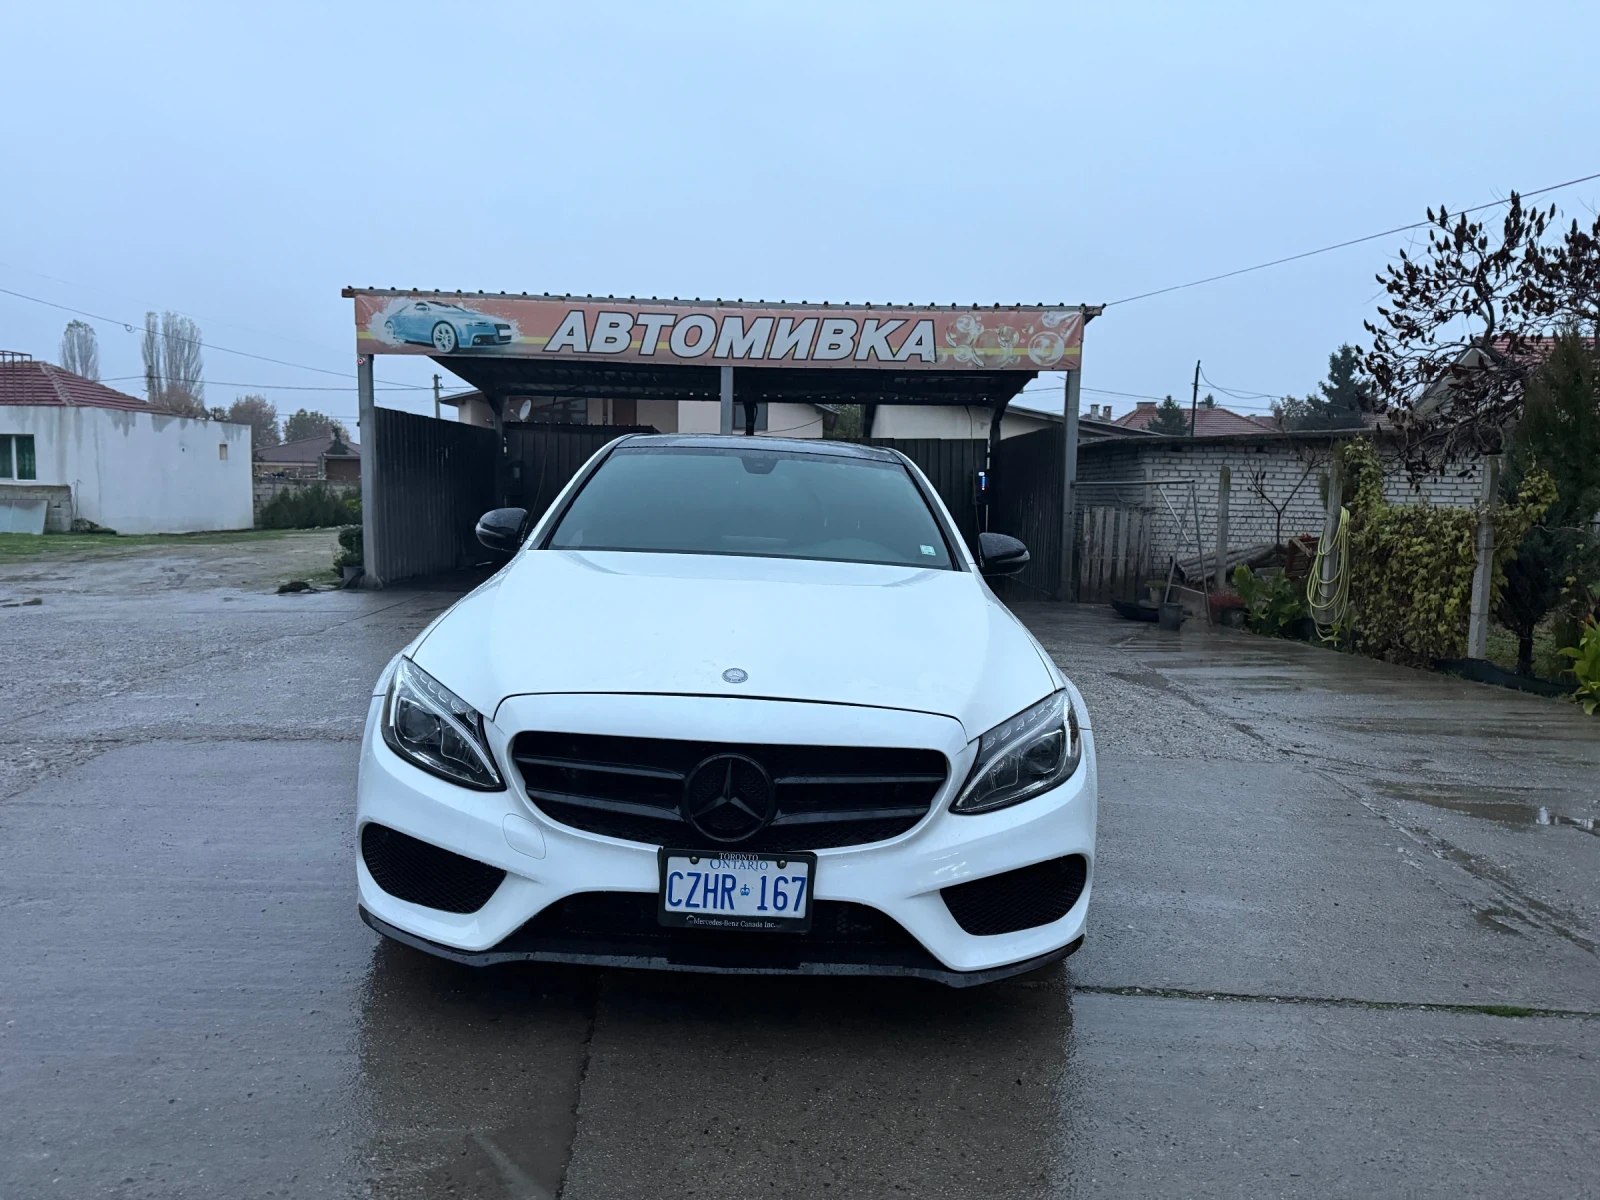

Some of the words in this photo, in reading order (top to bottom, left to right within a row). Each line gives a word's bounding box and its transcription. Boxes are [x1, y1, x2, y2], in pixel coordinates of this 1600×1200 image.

[543, 309, 936, 364] АВТОМИВКА
[718, 852, 759, 861] TORONTO
[709, 859, 769, 872] ONTARIO
[667, 871, 737, 910] CZHR
[757, 875, 806, 912] 167
[693, 917, 739, 927] Mercedes-Benz
[740, 920, 763, 928] Canada
